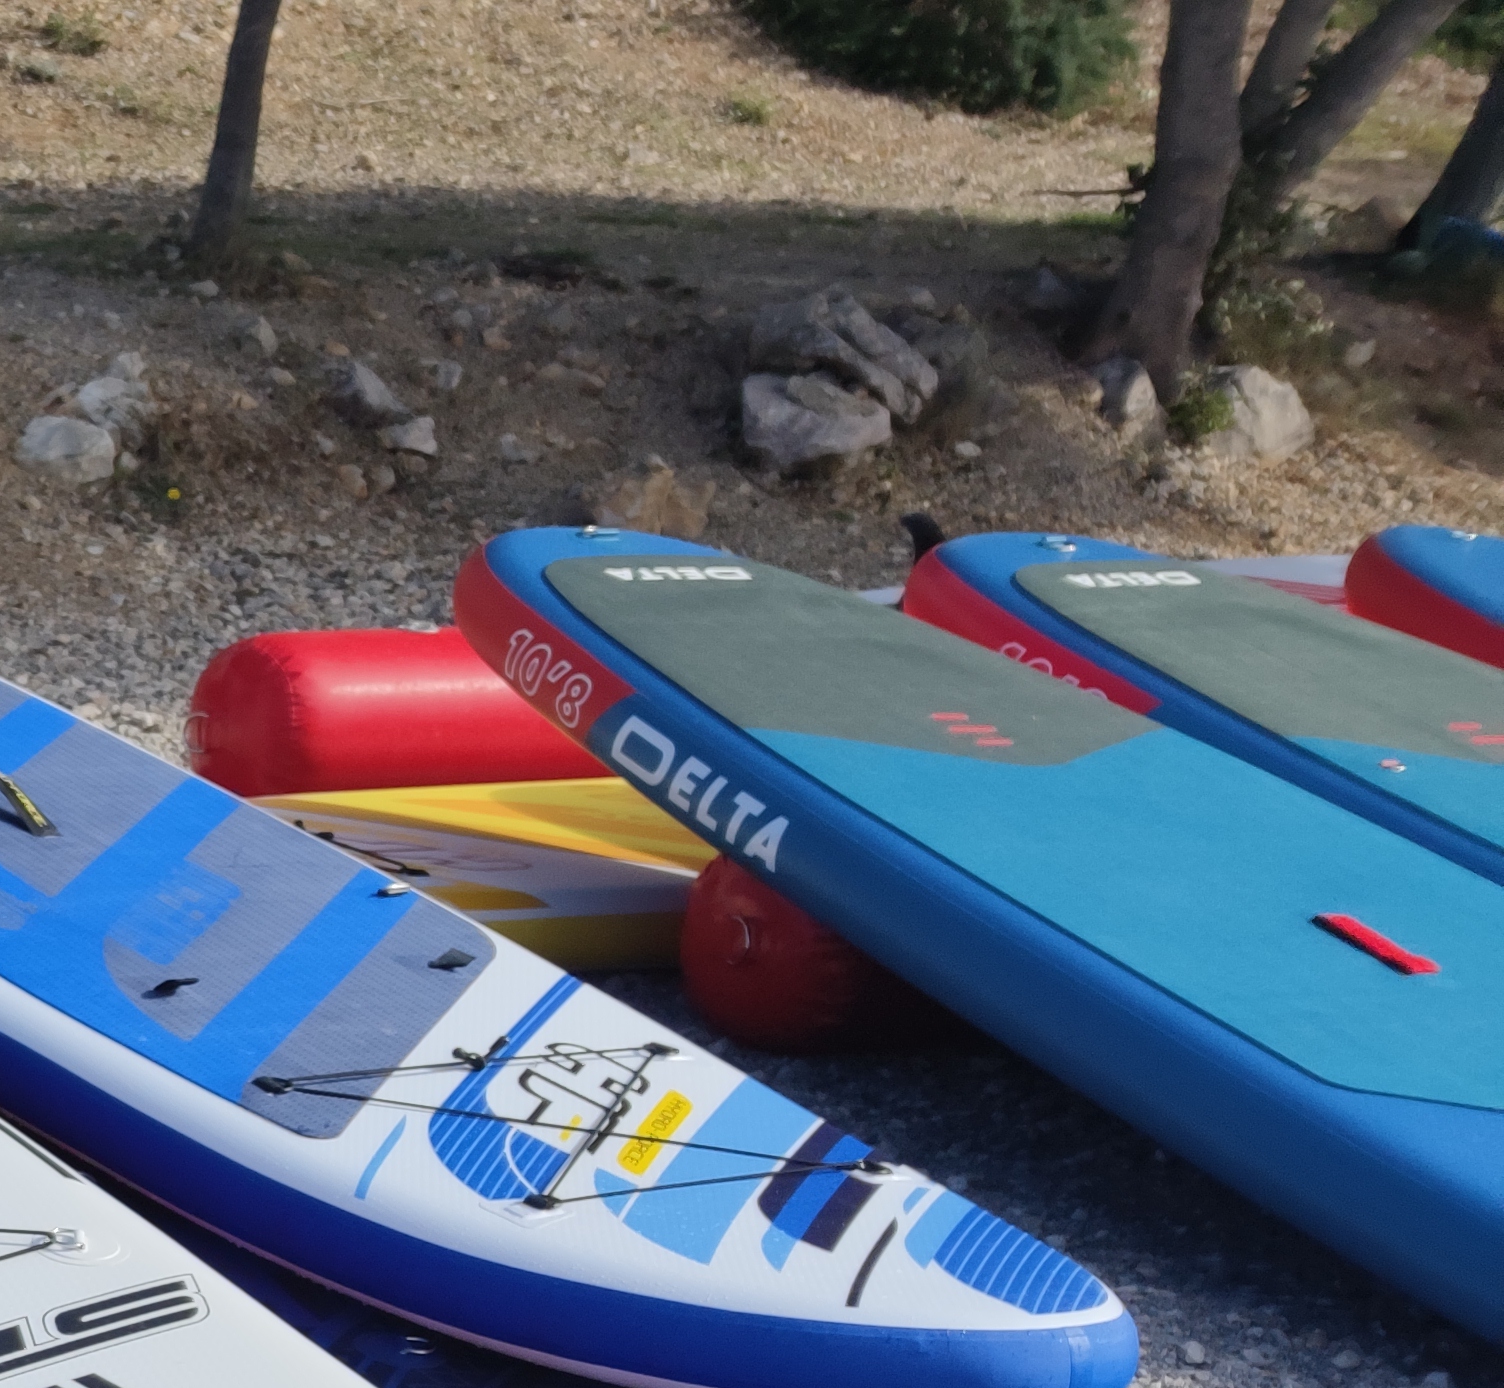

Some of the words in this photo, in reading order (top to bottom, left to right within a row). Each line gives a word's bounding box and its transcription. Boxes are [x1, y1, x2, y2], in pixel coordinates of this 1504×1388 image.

[603, 566, 752, 581] DELTA
[1065, 571, 1201, 588] DELTA
[611, 714, 789, 874] DELTA
